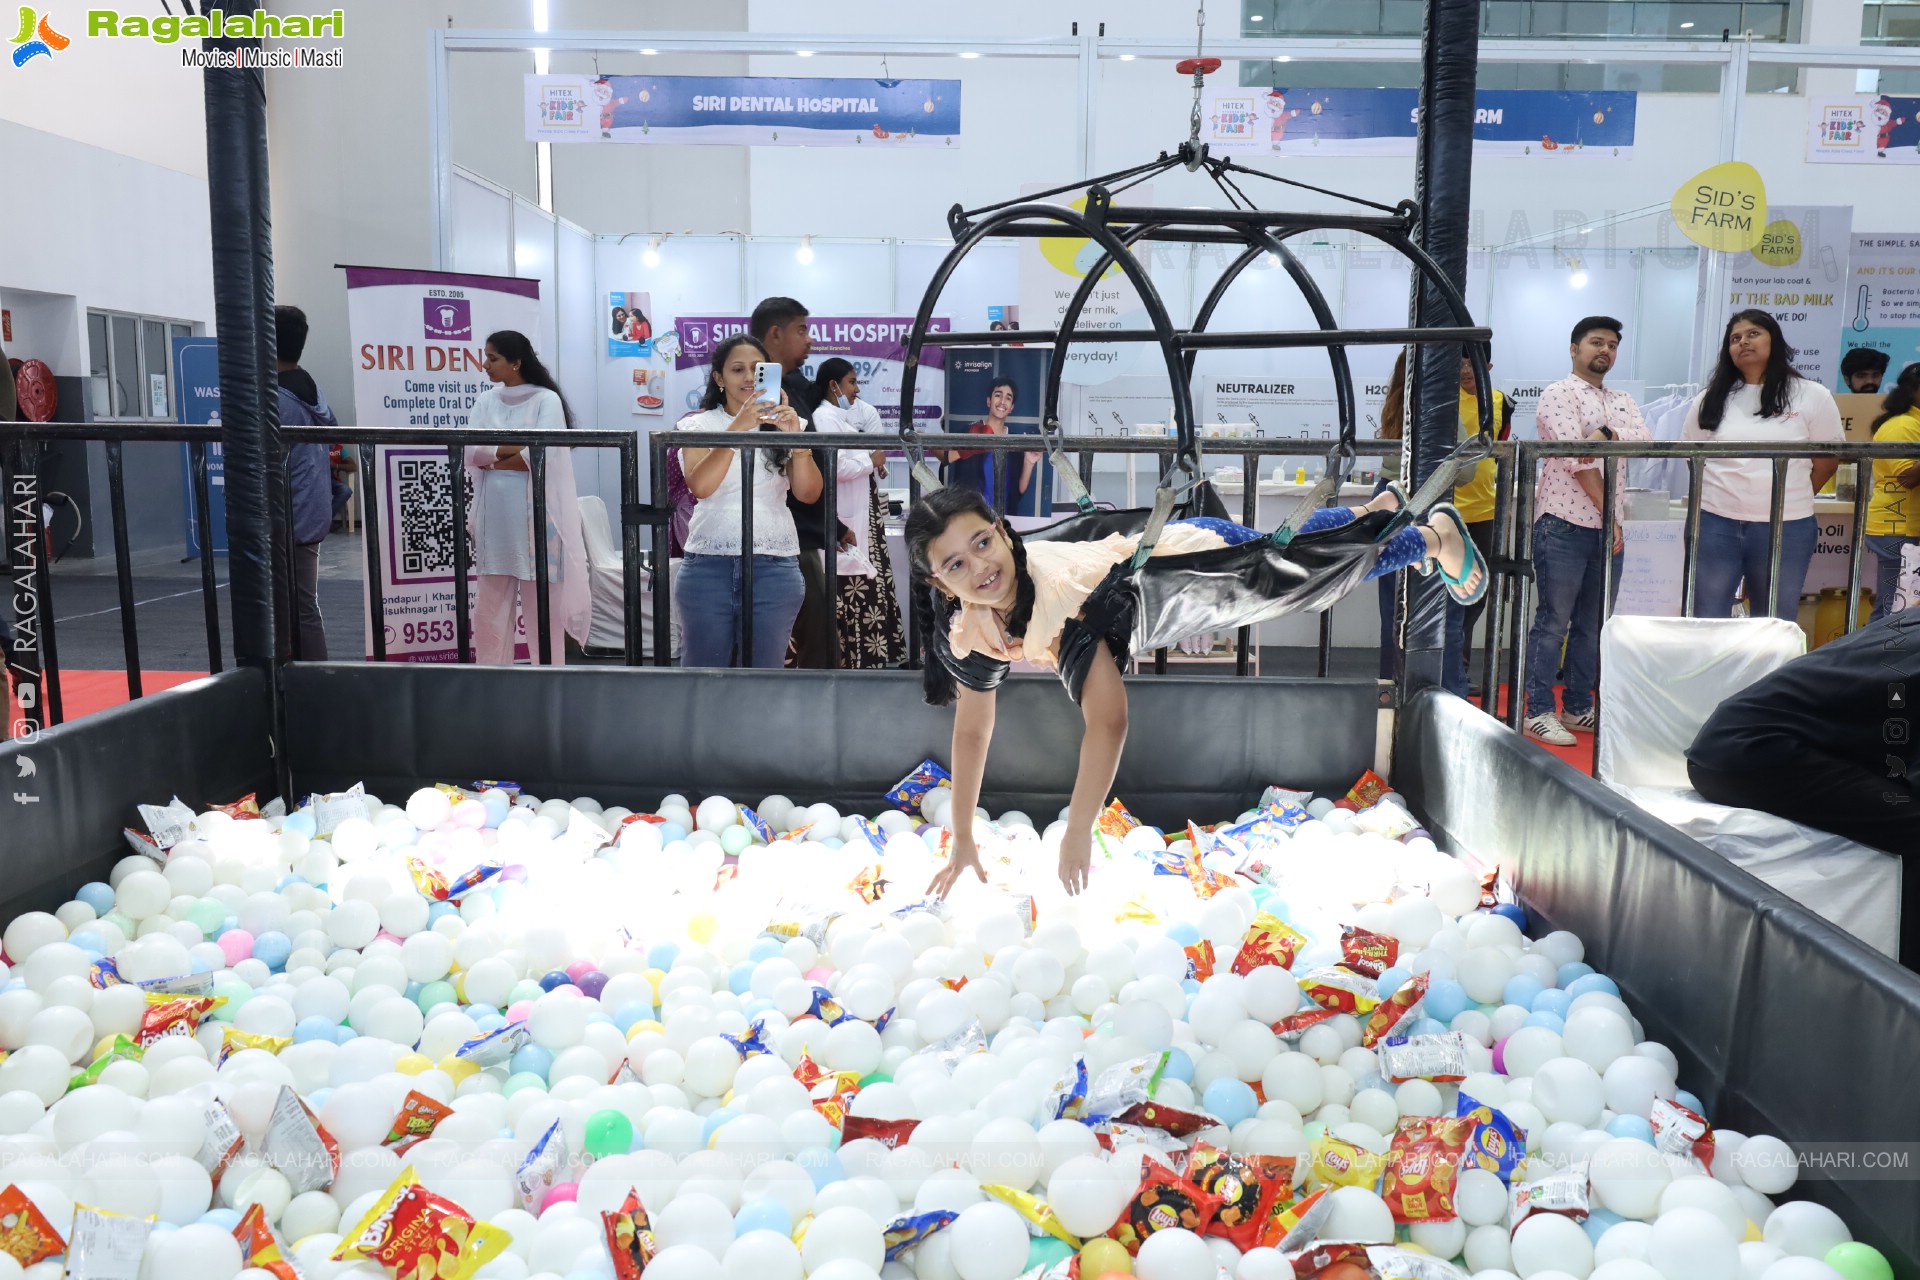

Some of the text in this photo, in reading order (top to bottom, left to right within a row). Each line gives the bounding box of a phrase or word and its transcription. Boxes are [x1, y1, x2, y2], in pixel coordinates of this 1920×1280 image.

[549, 89, 573, 97] HITEX
[692, 95, 879, 113] SIRI DENTAL HOSPITAL
[1222, 102, 1245, 110] HITEX
[549, 111, 574, 121] FAIR
[1474, 108, 1504, 125] RM
[1220, 124, 1245, 134] FAIR
[1828, 131, 1852, 141] FAIR
[1690, 206, 1752, 232] FARM
[1760, 244, 1794, 254] FARM
[1860, 240, 1874, 248] THE
[1910, 240, 1920, 248] SA
[1755, 278, 1772, 286] your
[1054, 290, 1070, 299] We
[1102, 291, 1120, 302] just
[1746, 292, 1770, 305] THE
[1774, 293, 1800, 306] BAD
[1803, 294, 1834, 306] MILK
[1094, 306, 1118, 316] milk,
[361, 344, 483, 372] SIRI DEN
[964, 360, 992, 368] invisalign
[1064, 352, 1118, 364] veryday!
[194, 386, 221, 398] WAS
[404, 380, 434, 393] Come
[438, 380, 461, 393] visit
[464, 384, 477, 394] us
[1216, 384, 1295, 394] NEUTRALIZER
[384, 396, 436, 412] Complete
[440, 396, 462, 409] Oral
[410, 414, 469, 428] and get you
[1826, 524, 1844, 536] Oil
[1814, 542, 1850, 554] tives
[382, 596, 422, 604] ondapur
[384, 604, 438, 616] lsukhnagar
[382, 1208, 434, 1260] ORIGINA
